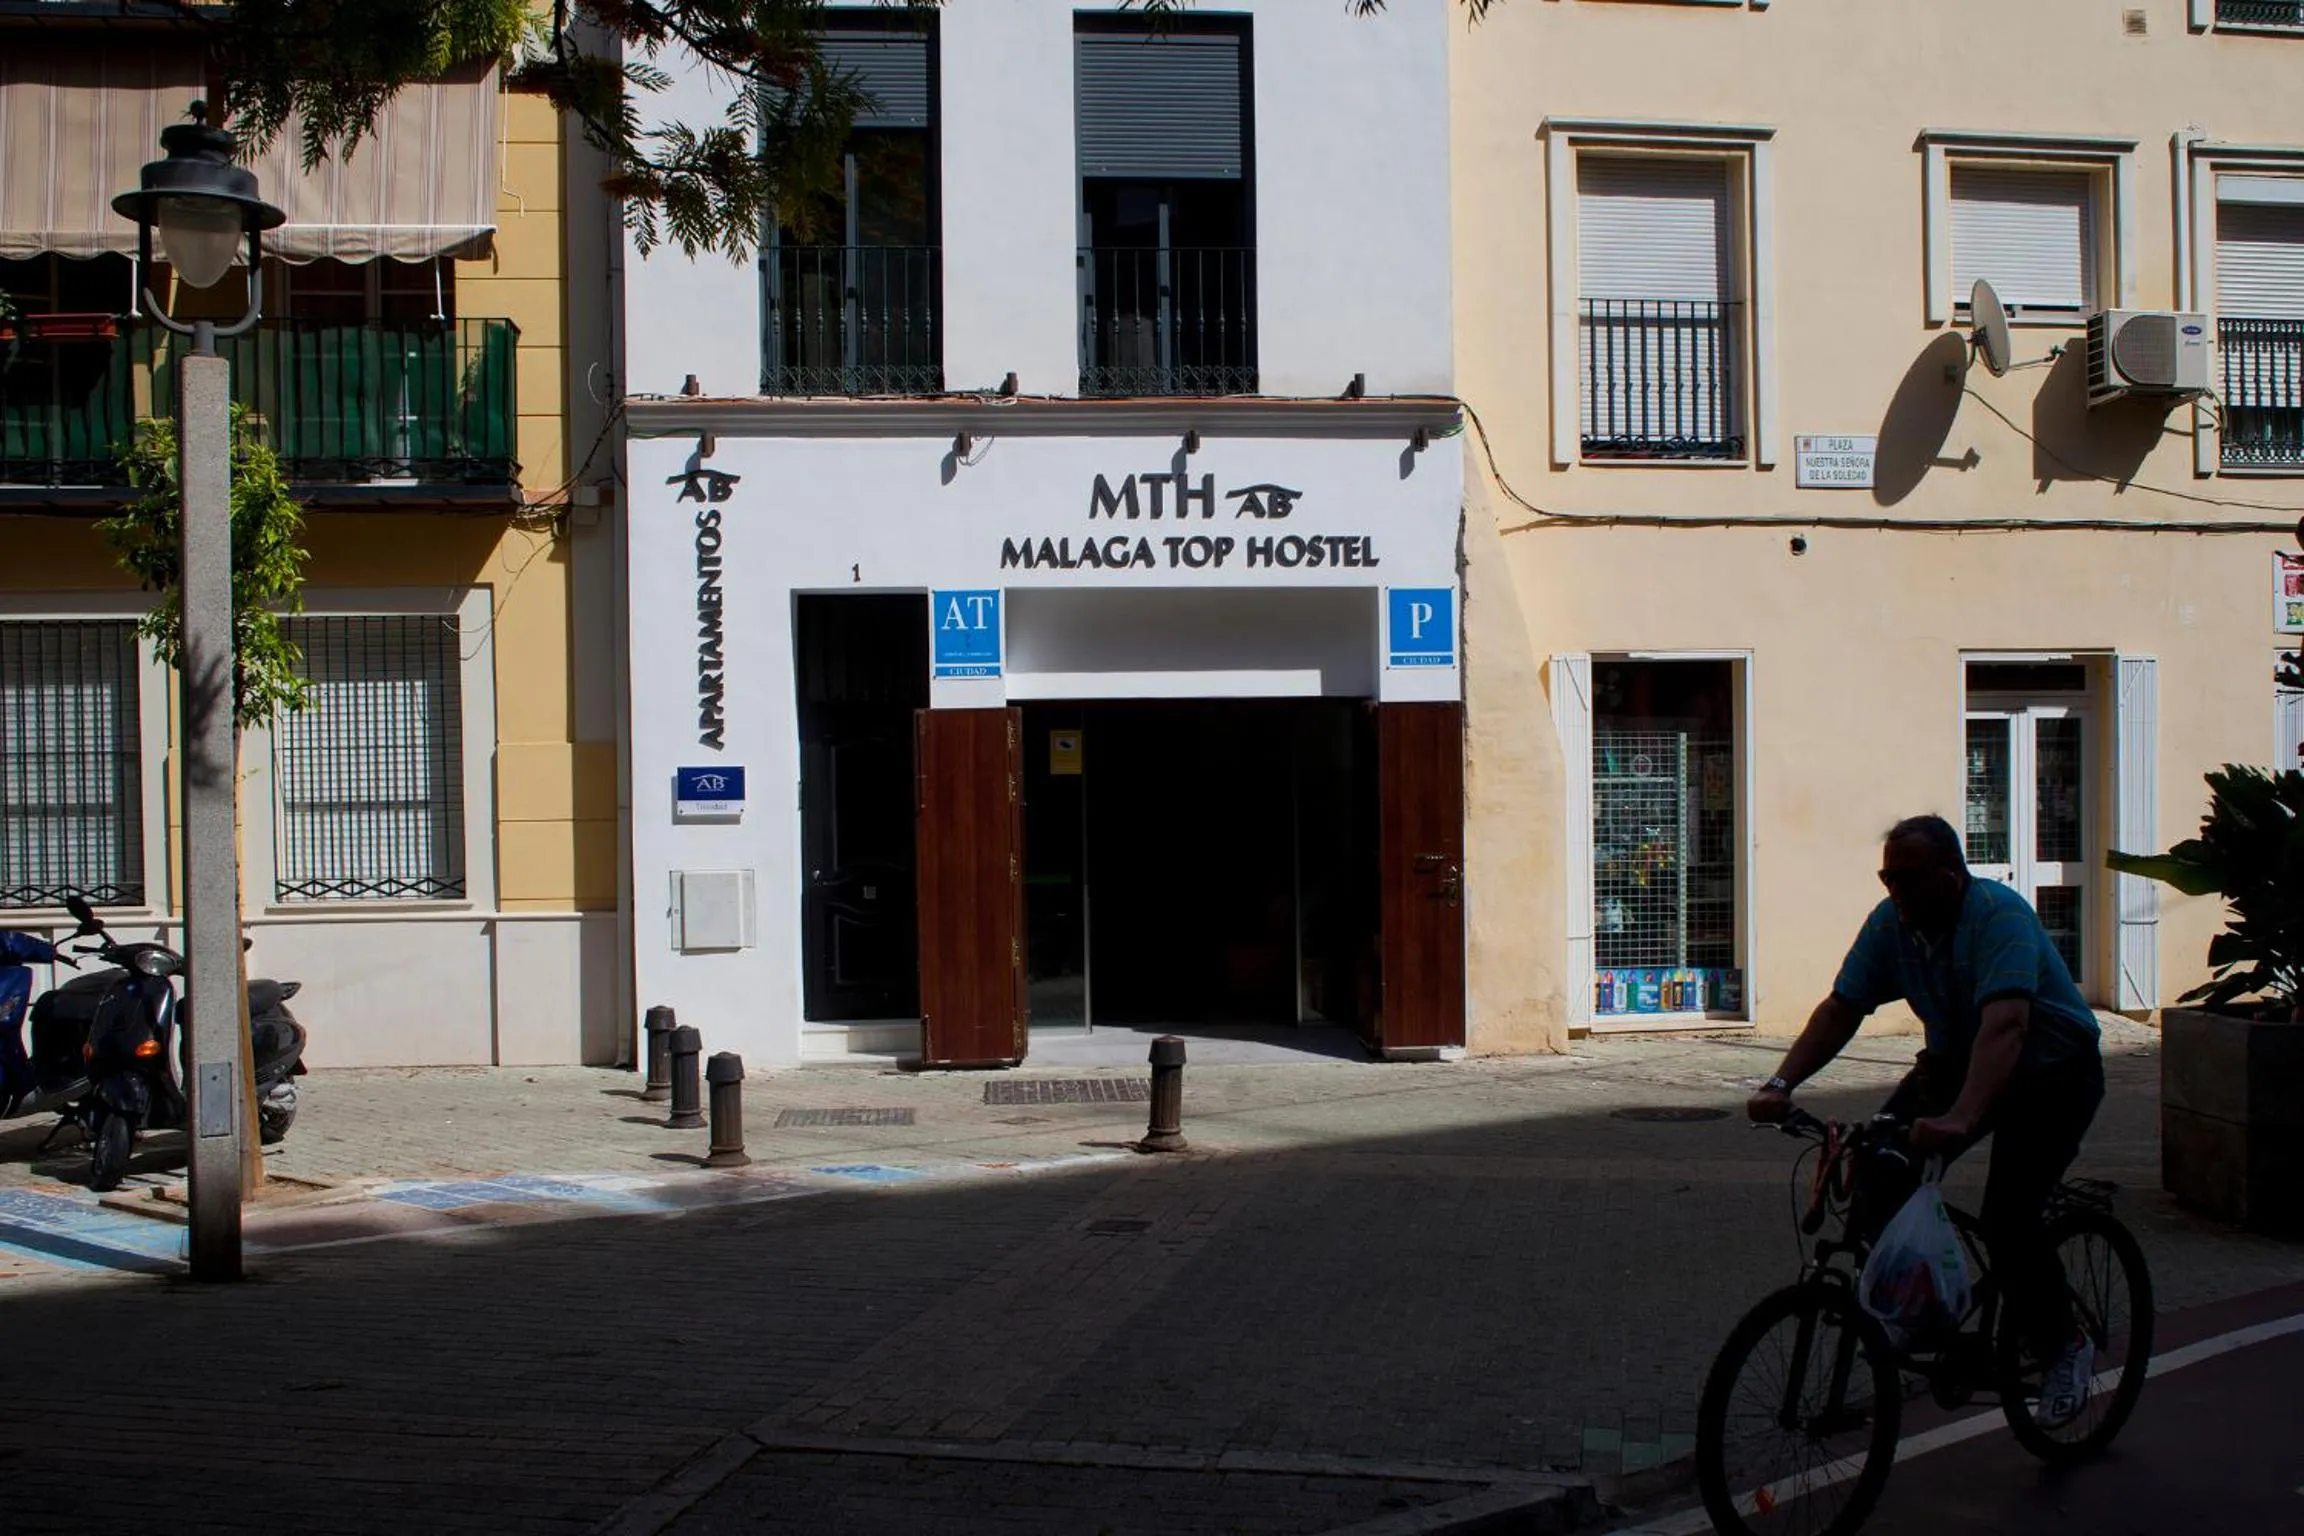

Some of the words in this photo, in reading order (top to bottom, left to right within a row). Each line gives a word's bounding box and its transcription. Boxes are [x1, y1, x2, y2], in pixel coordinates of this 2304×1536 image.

[1828, 439, 1853, 450] PLAZA
[1806, 457, 1838, 468] NUESTRA
[1808, 470, 1820, 480] DE
[1821, 470, 1832, 480] LA
[1833, 469, 1867, 480] SOLEDAD
[671, 472, 737, 504] AB
[1089, 473, 1215, 519] MTH
[1230, 487, 1299, 519] AB
[1000, 536, 1156, 569] MALAGA
[1163, 536, 1235, 568] TOP
[1246, 535, 1380, 568] HOSTEL
[851, 563, 861, 583] 1
[941, 596, 994, 631] AT
[1409, 602, 1433, 640] P
[695, 509, 725, 752] APARTAMENTOS
[949, 667, 987, 676] CIUDAD
